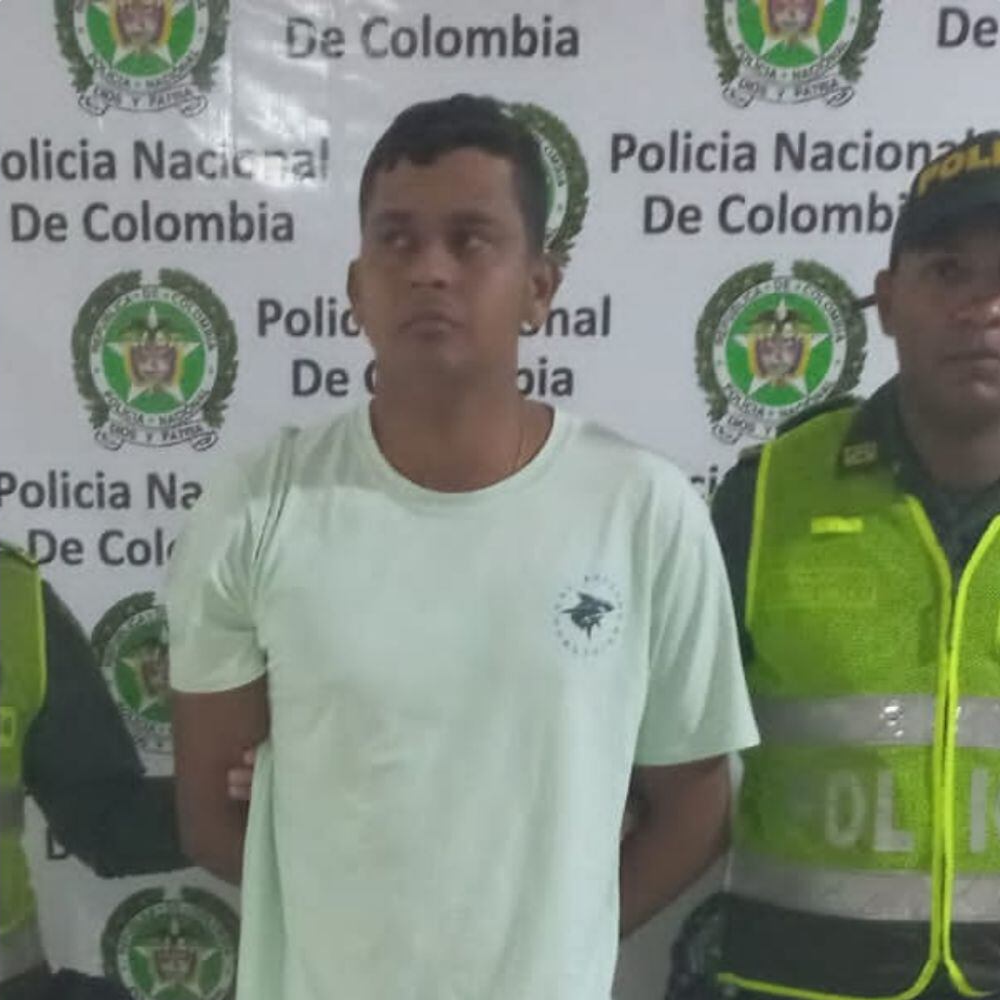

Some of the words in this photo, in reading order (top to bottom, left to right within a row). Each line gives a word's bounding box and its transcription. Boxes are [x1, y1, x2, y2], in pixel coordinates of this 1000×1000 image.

[286, 17, 346, 59] De
[361, 14, 580, 58] Colombia
[936, 7, 999, 49] De
[1, 138, 117, 181] olicia
[610, 130, 756, 174] Policia
[10, 203, 68, 243] De
[83, 199, 294, 243] Colombia
[644, 194, 703, 235] De
[292, 358, 350, 397] De
[27, 529, 84, 567] De
